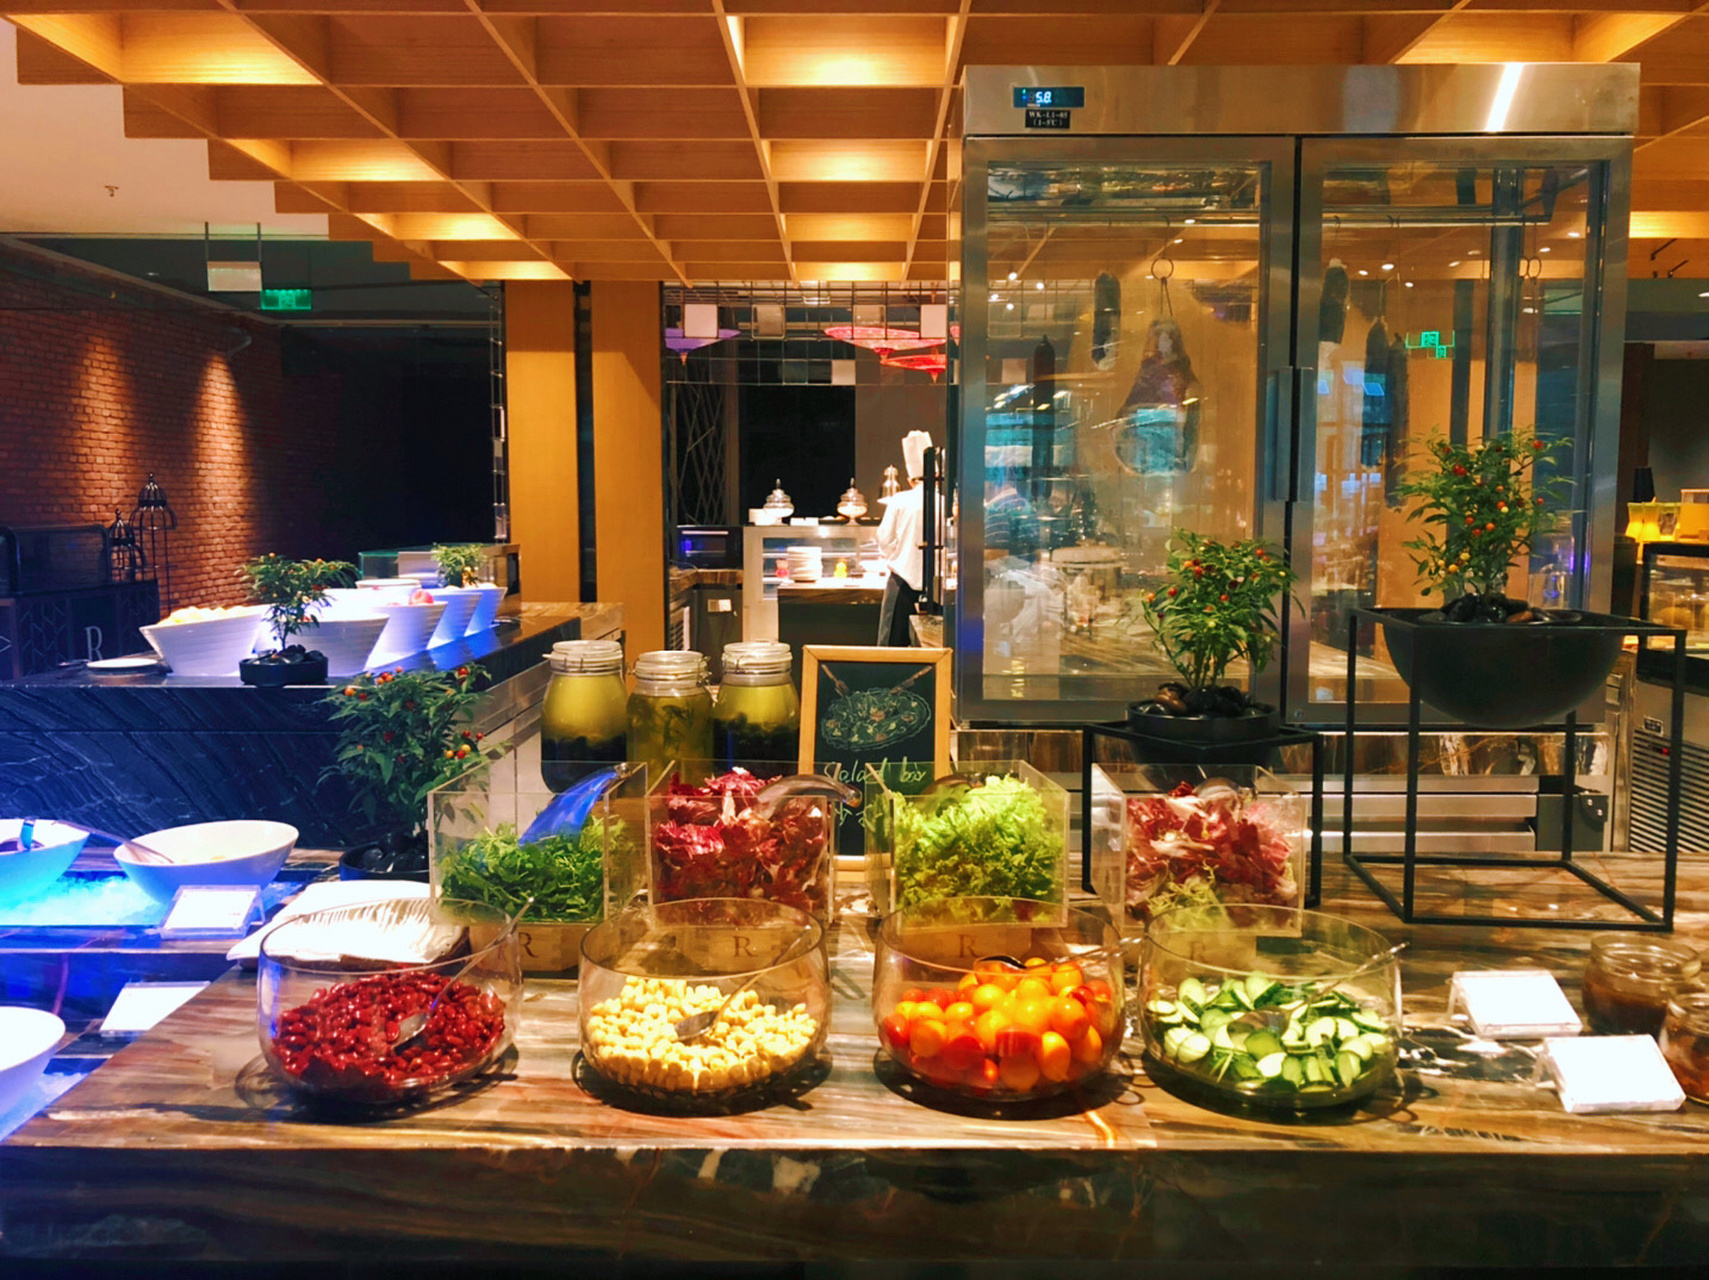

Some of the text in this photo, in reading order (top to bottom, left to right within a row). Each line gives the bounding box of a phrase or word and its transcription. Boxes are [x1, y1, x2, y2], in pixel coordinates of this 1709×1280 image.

[84, 626, 103, 661] R
[900, 756, 928, 783] bar
[518, 931, 539, 958] R
[733, 935, 757, 958] R
[958, 934, 981, 959] R
